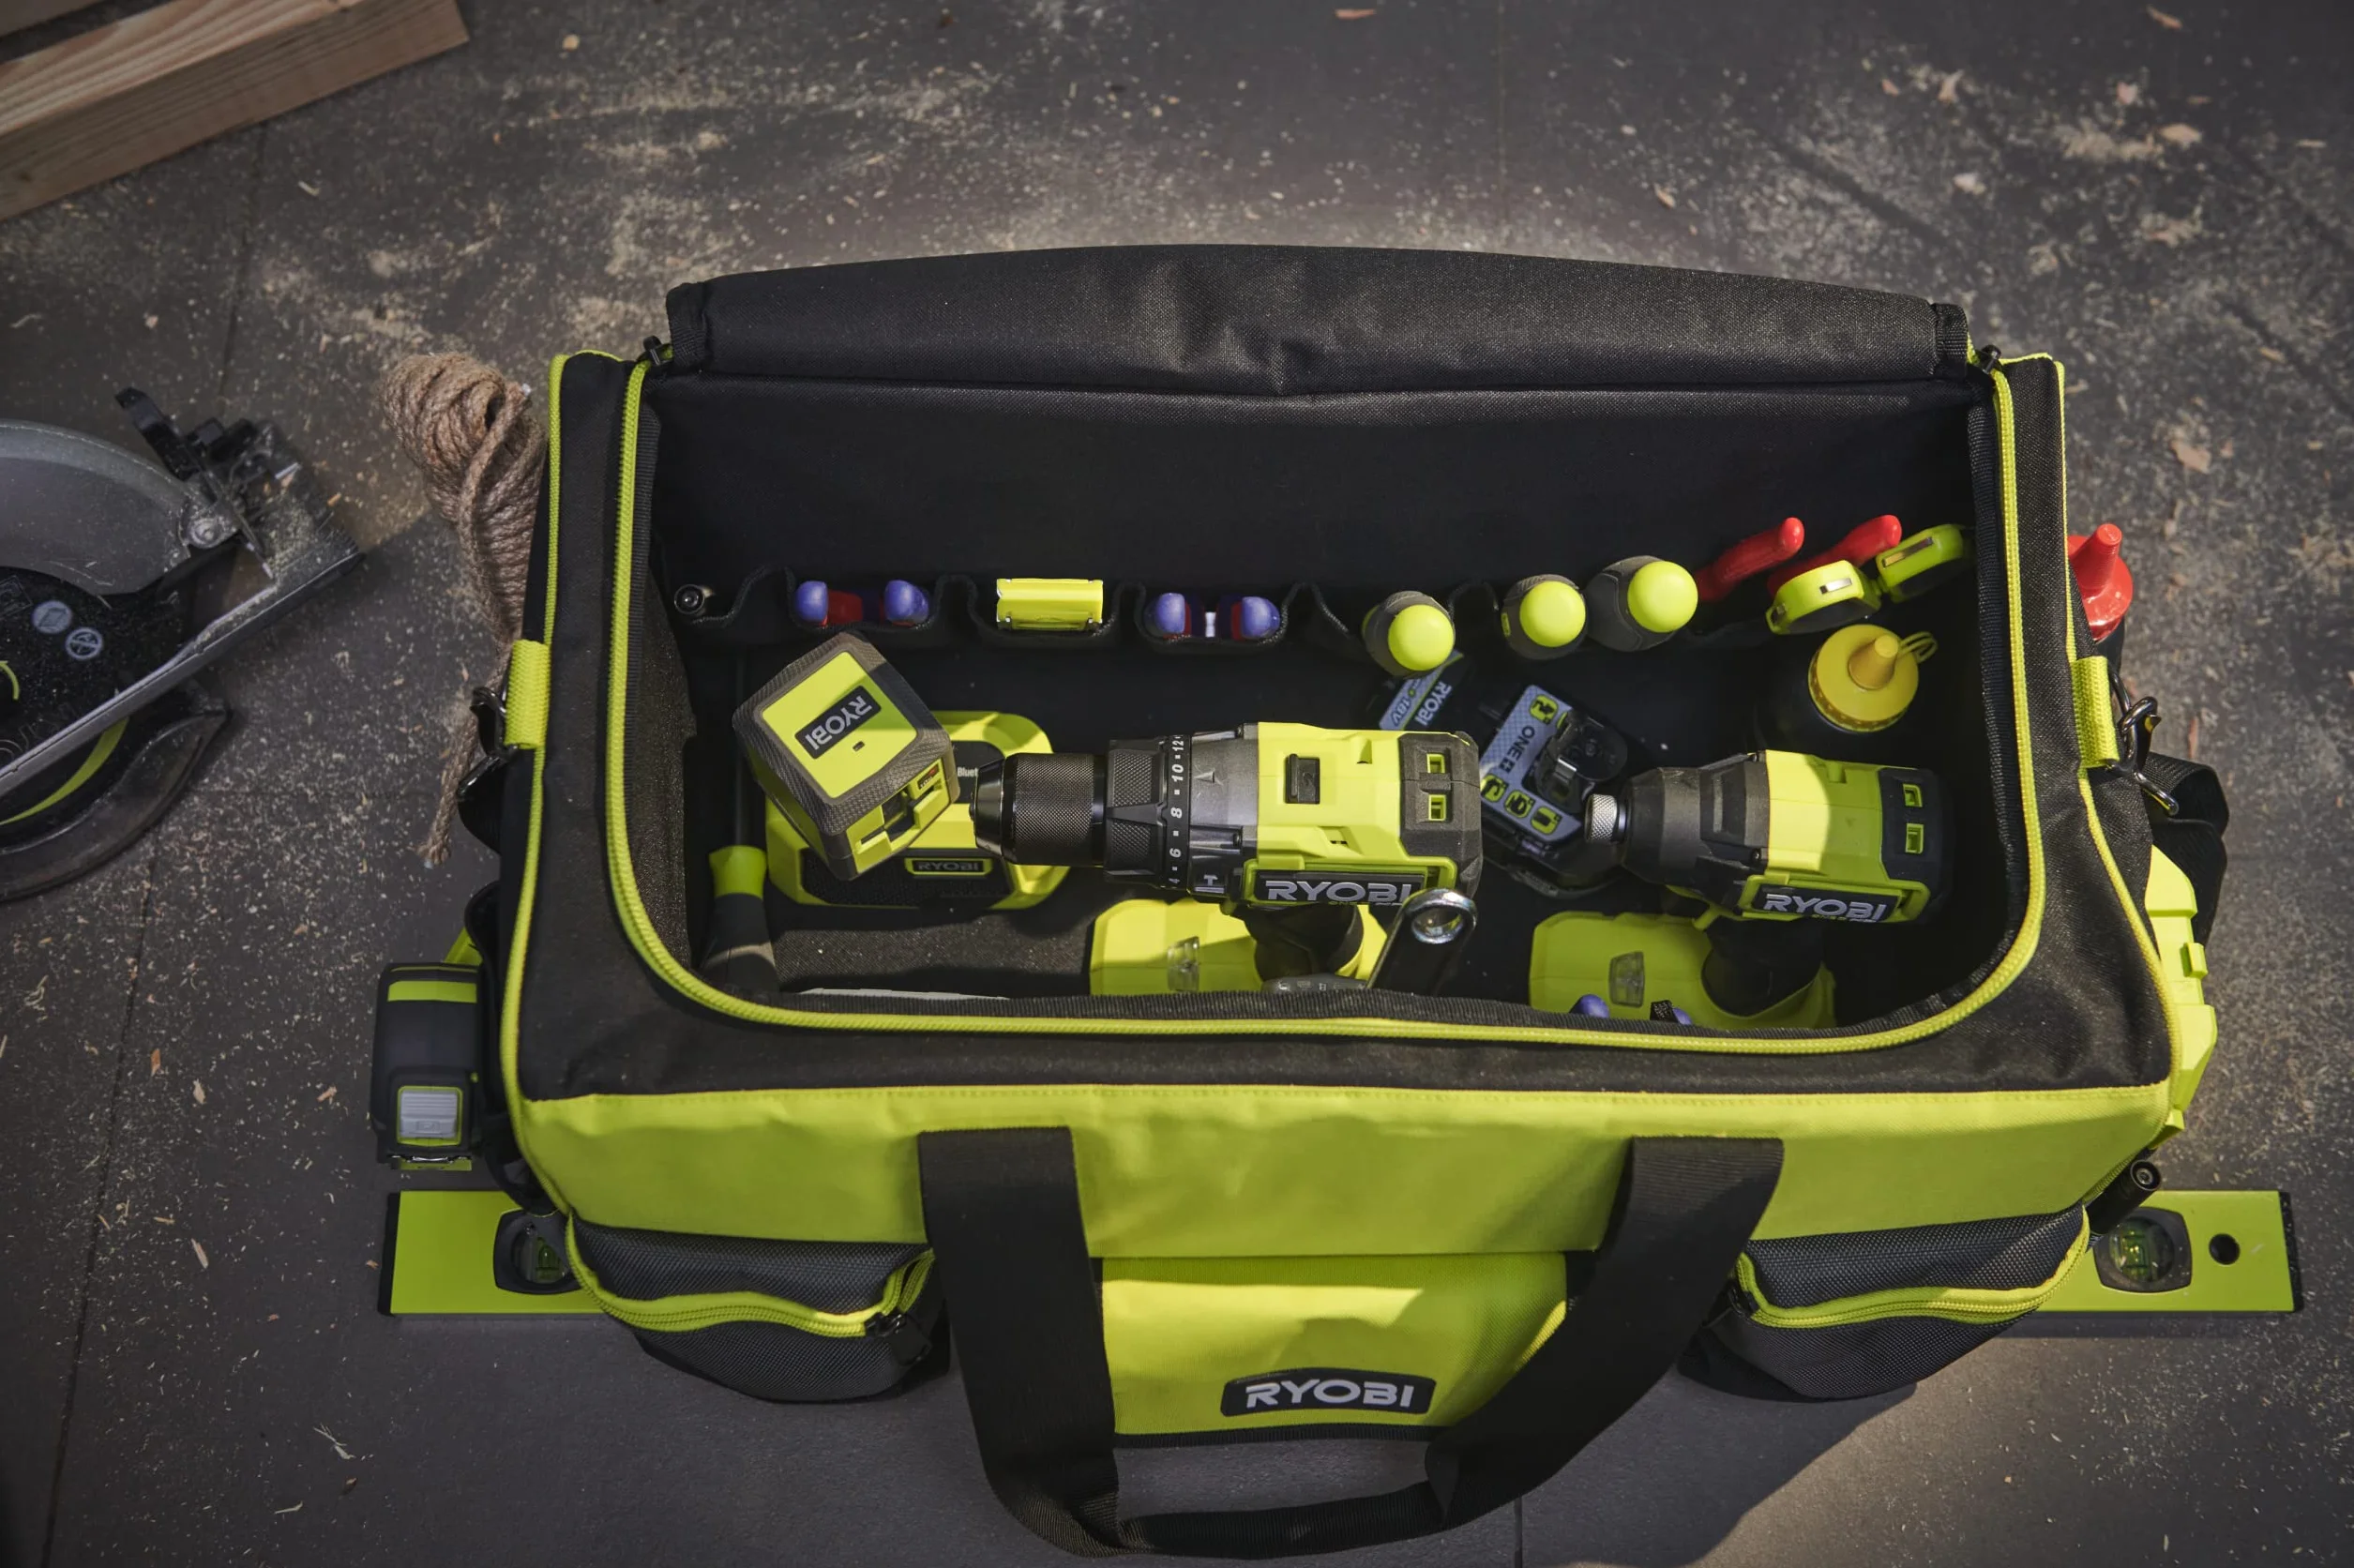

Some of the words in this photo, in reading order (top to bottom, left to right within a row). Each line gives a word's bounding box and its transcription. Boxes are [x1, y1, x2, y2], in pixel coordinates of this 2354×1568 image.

[1414, 681, 1453, 726] RYOBI
[805, 695, 872, 750] RYOBI
[1171, 764, 1185, 782] 10
[1170, 807, 1183, 819] 8
[1169, 848, 1182, 858] 6
[918, 861, 980, 871] RYOBI
[1265, 880, 1411, 903] RYOBI
[1763, 893, 1887, 921] RYOBI
[1245, 1379, 1413, 1409] RYOBI
